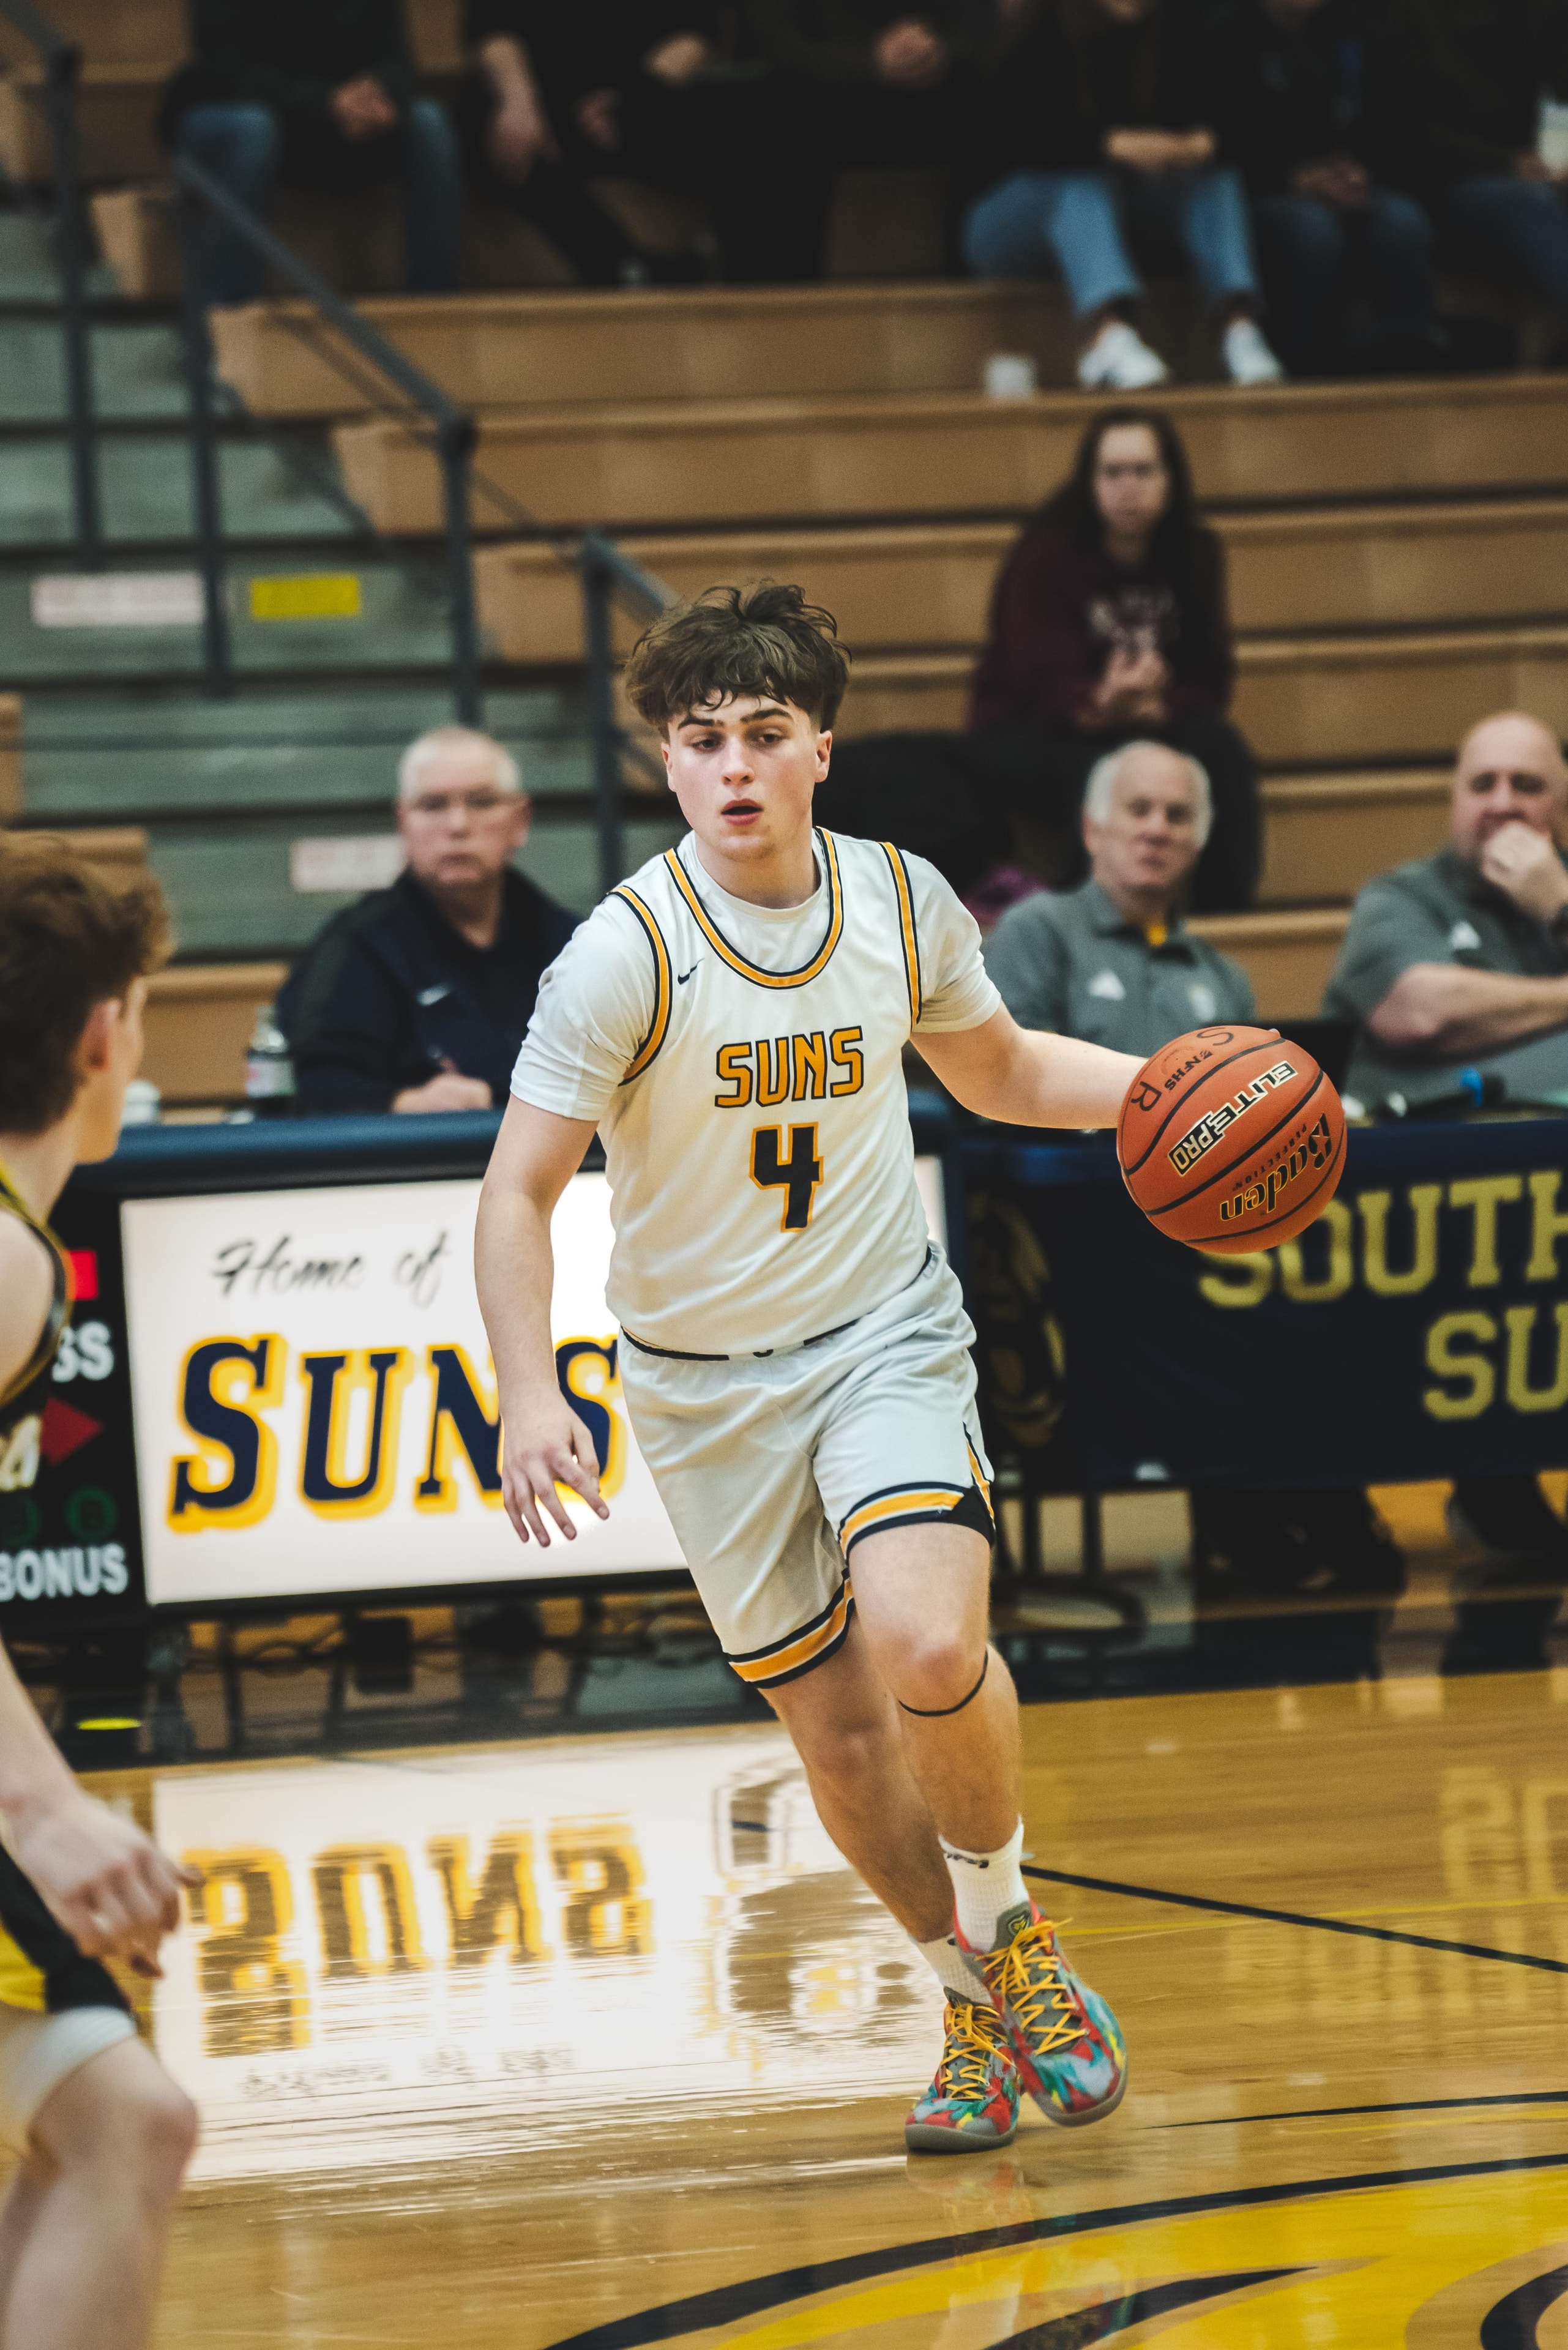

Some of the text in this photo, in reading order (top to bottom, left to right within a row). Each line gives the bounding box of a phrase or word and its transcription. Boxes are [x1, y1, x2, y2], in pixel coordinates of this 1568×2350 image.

[715, 1026, 864, 1108] SUNS
[1130, 1081, 1162, 1112] R
[1164, 1056, 1201, 1091] NFHS
[1168, 1061, 1298, 1177] ELITE PRO
[749, 1121, 824, 1233] 4
[1220, 1112, 1332, 1222] Baden
[212, 1230, 451, 1308] Home of
